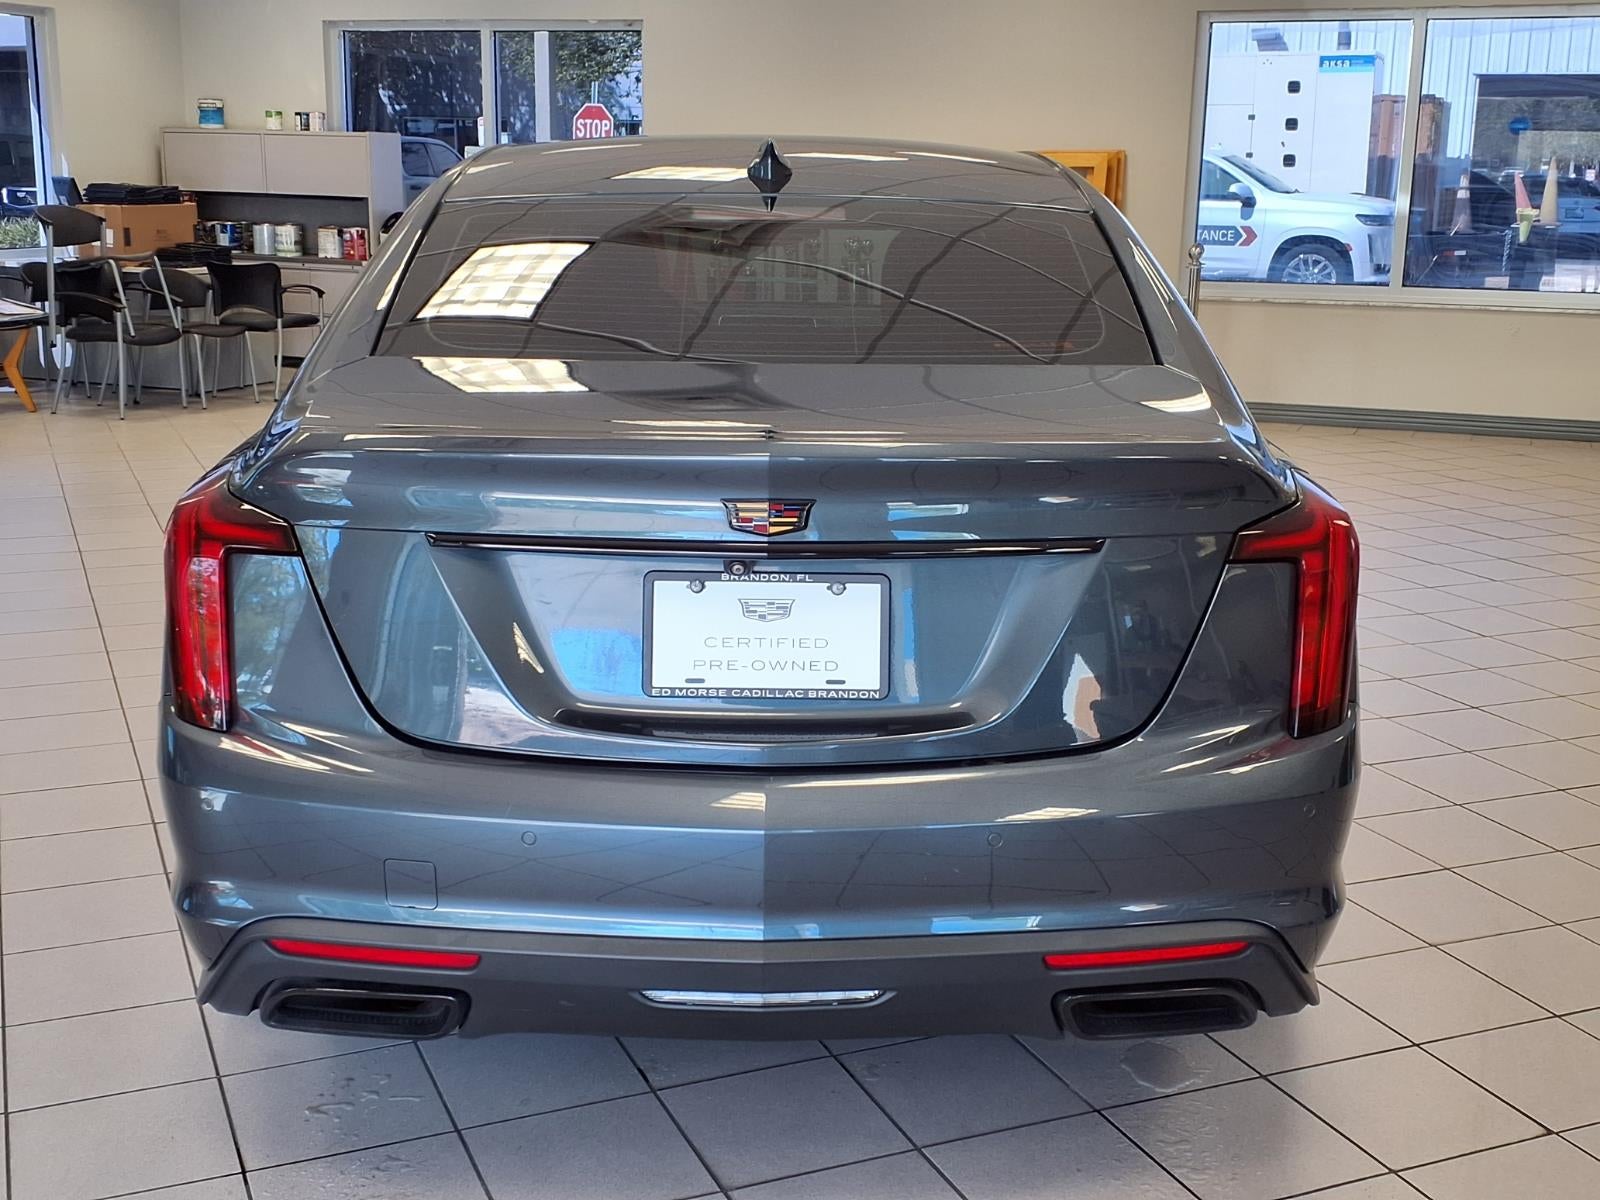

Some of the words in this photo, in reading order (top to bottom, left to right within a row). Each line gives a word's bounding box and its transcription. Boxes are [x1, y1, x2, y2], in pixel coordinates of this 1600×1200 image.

[576, 119, 610, 138] STOP
[796, 574, 814, 582] FL
[704, 636, 829, 649] CERTIFIED
[692, 659, 839, 672] PRE-OWNED
[652, 688, 671, 697] ED
[675, 688, 726, 697] MORSE
[731, 689, 804, 698] CADILLAC
[808, 690, 880, 699] BRANDON
